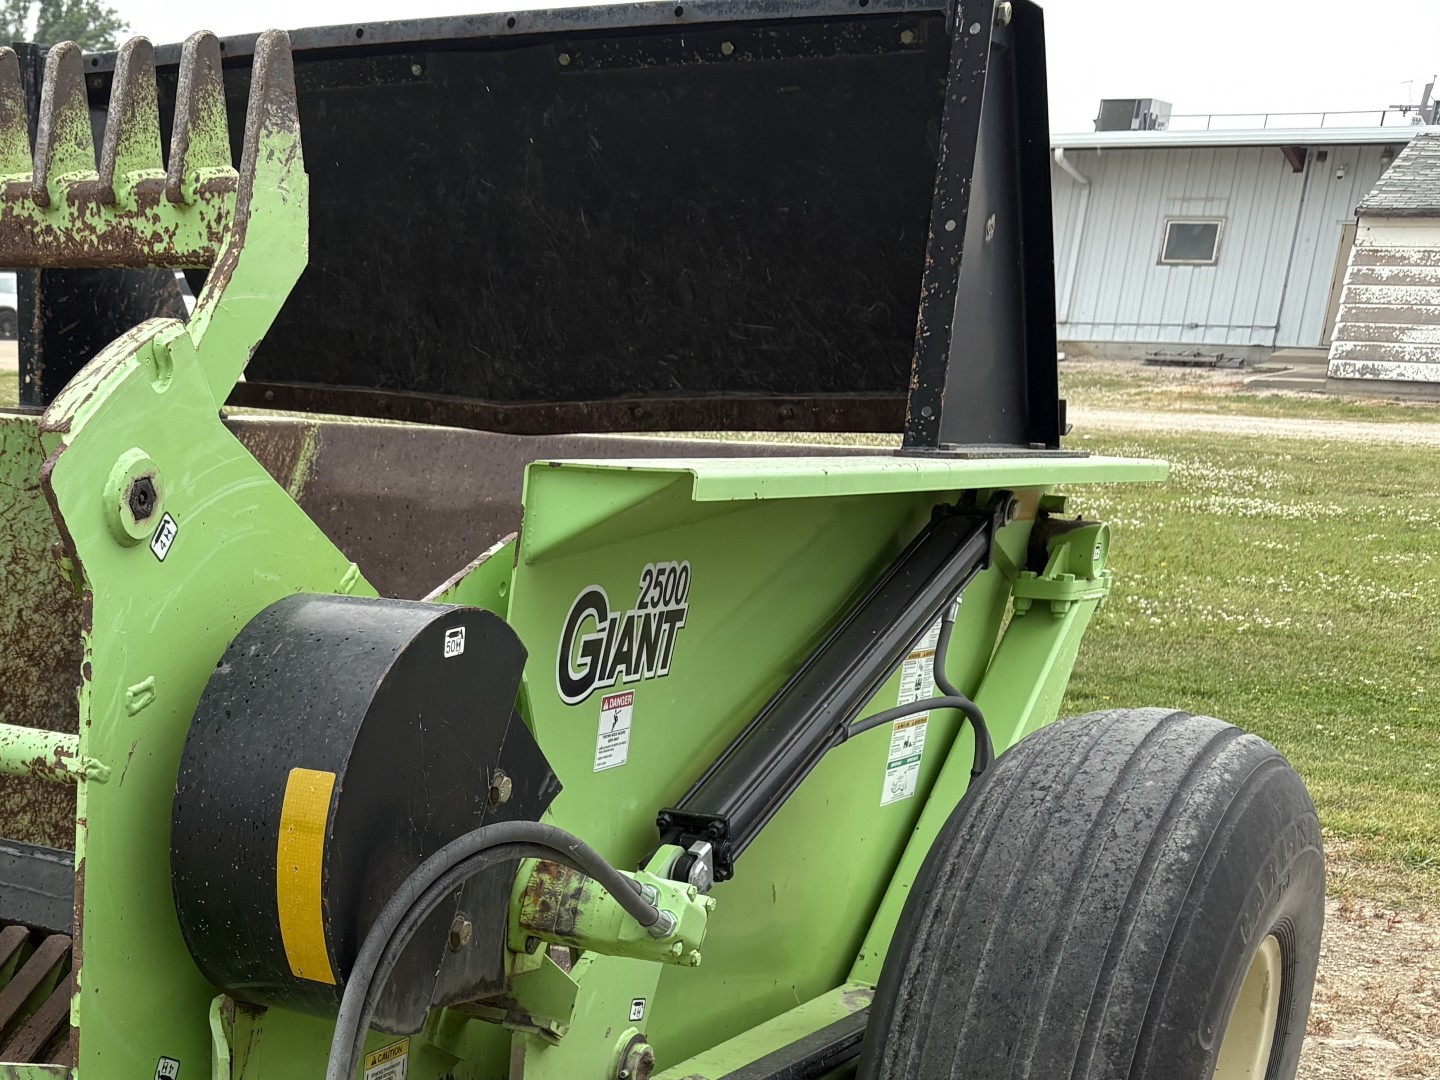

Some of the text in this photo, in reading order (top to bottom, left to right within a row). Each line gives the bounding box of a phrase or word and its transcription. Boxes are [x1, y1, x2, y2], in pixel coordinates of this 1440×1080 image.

[637, 563, 689, 610] 2500
[557, 588, 687, 698] GIANT
[609, 693, 633, 709] DANGER
[378, 1046, 403, 1062] CAUTION
